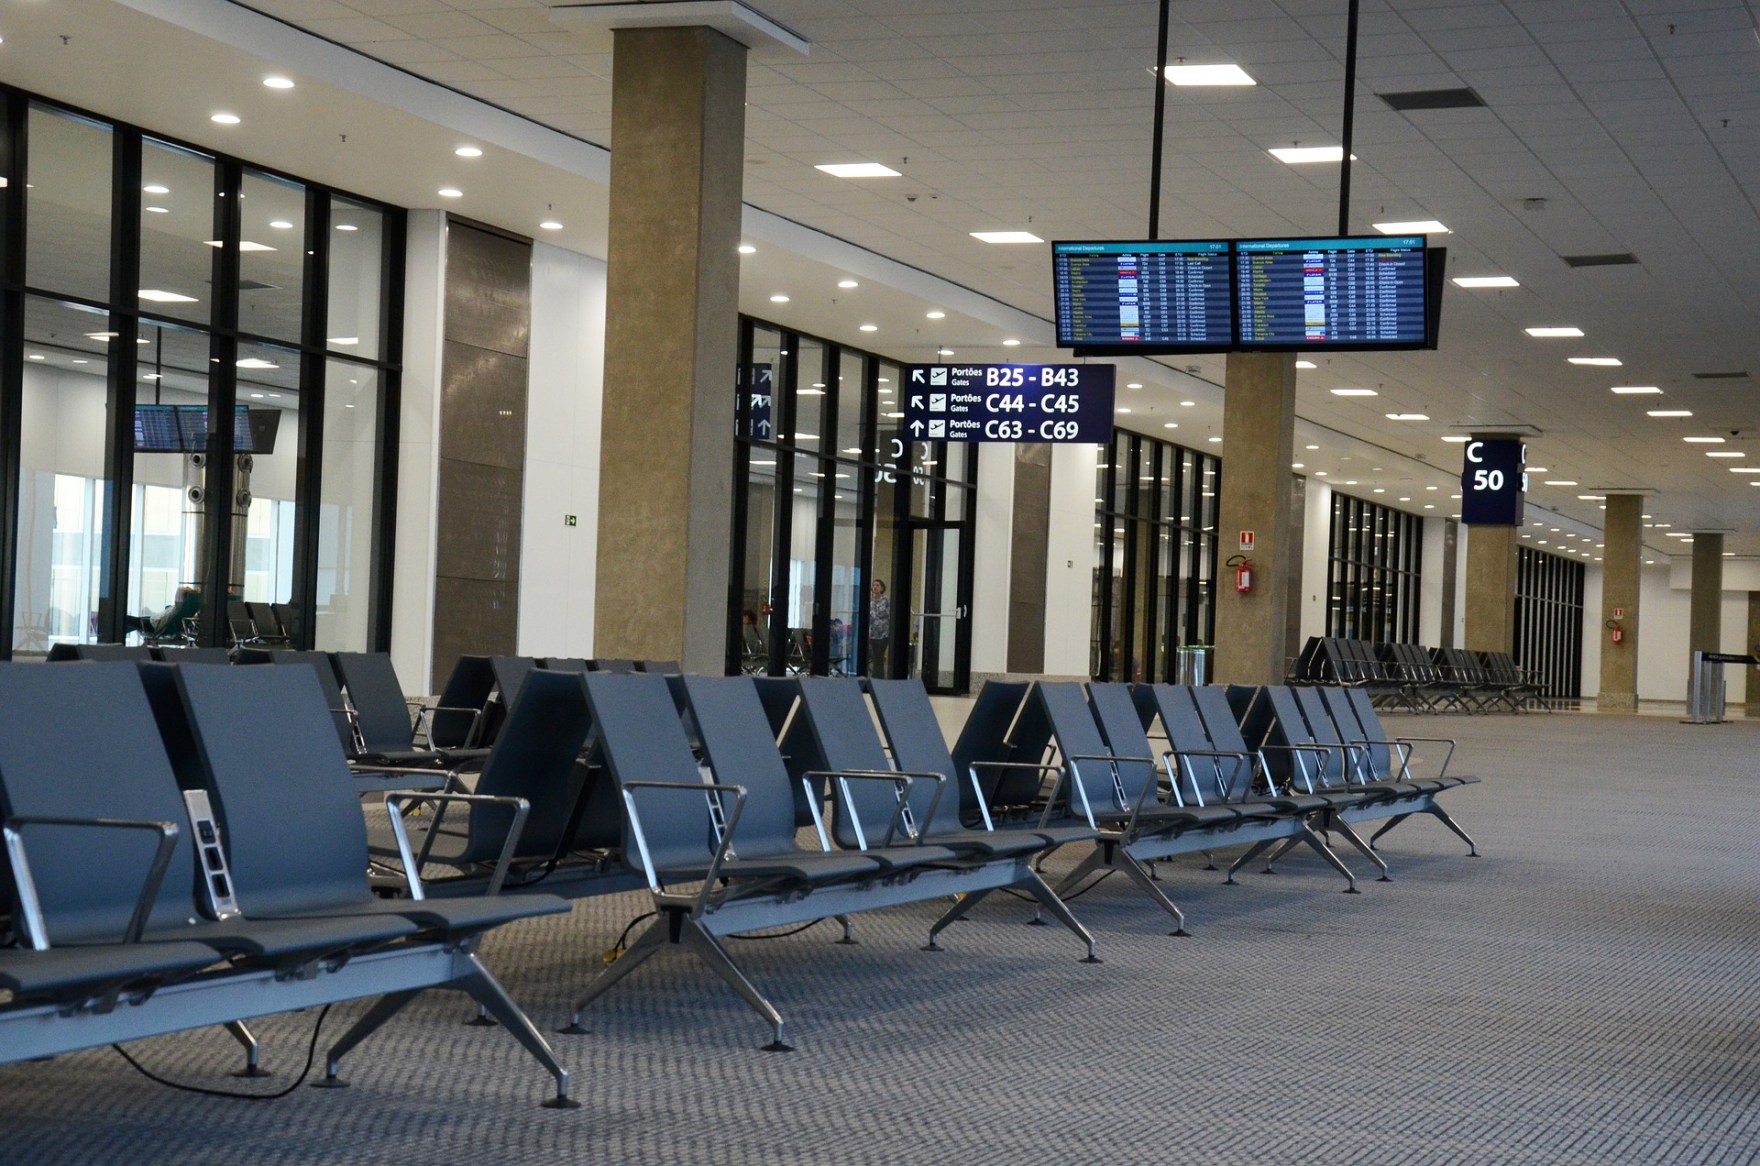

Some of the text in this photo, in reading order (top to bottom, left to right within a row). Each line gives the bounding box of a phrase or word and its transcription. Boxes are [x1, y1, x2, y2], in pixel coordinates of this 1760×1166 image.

[951, 367, 983, 377] Portões
[986, 367, 1024, 387] B25
[1040, 367, 1079, 387] B43
[951, 378, 970, 386] Gates
[950, 393, 982, 403] Portões
[950, 404, 969, 413] Gates
[985, 393, 1025, 413] C44
[1040, 393, 1080, 414] C45
[949, 419, 981, 429] Portões
[949, 430, 968, 439] Gates
[984, 419, 1023, 439] C63
[1039, 420, 1079, 440] C69
[1466, 441, 1484, 463] C
[1473, 469, 1504, 491] 50
